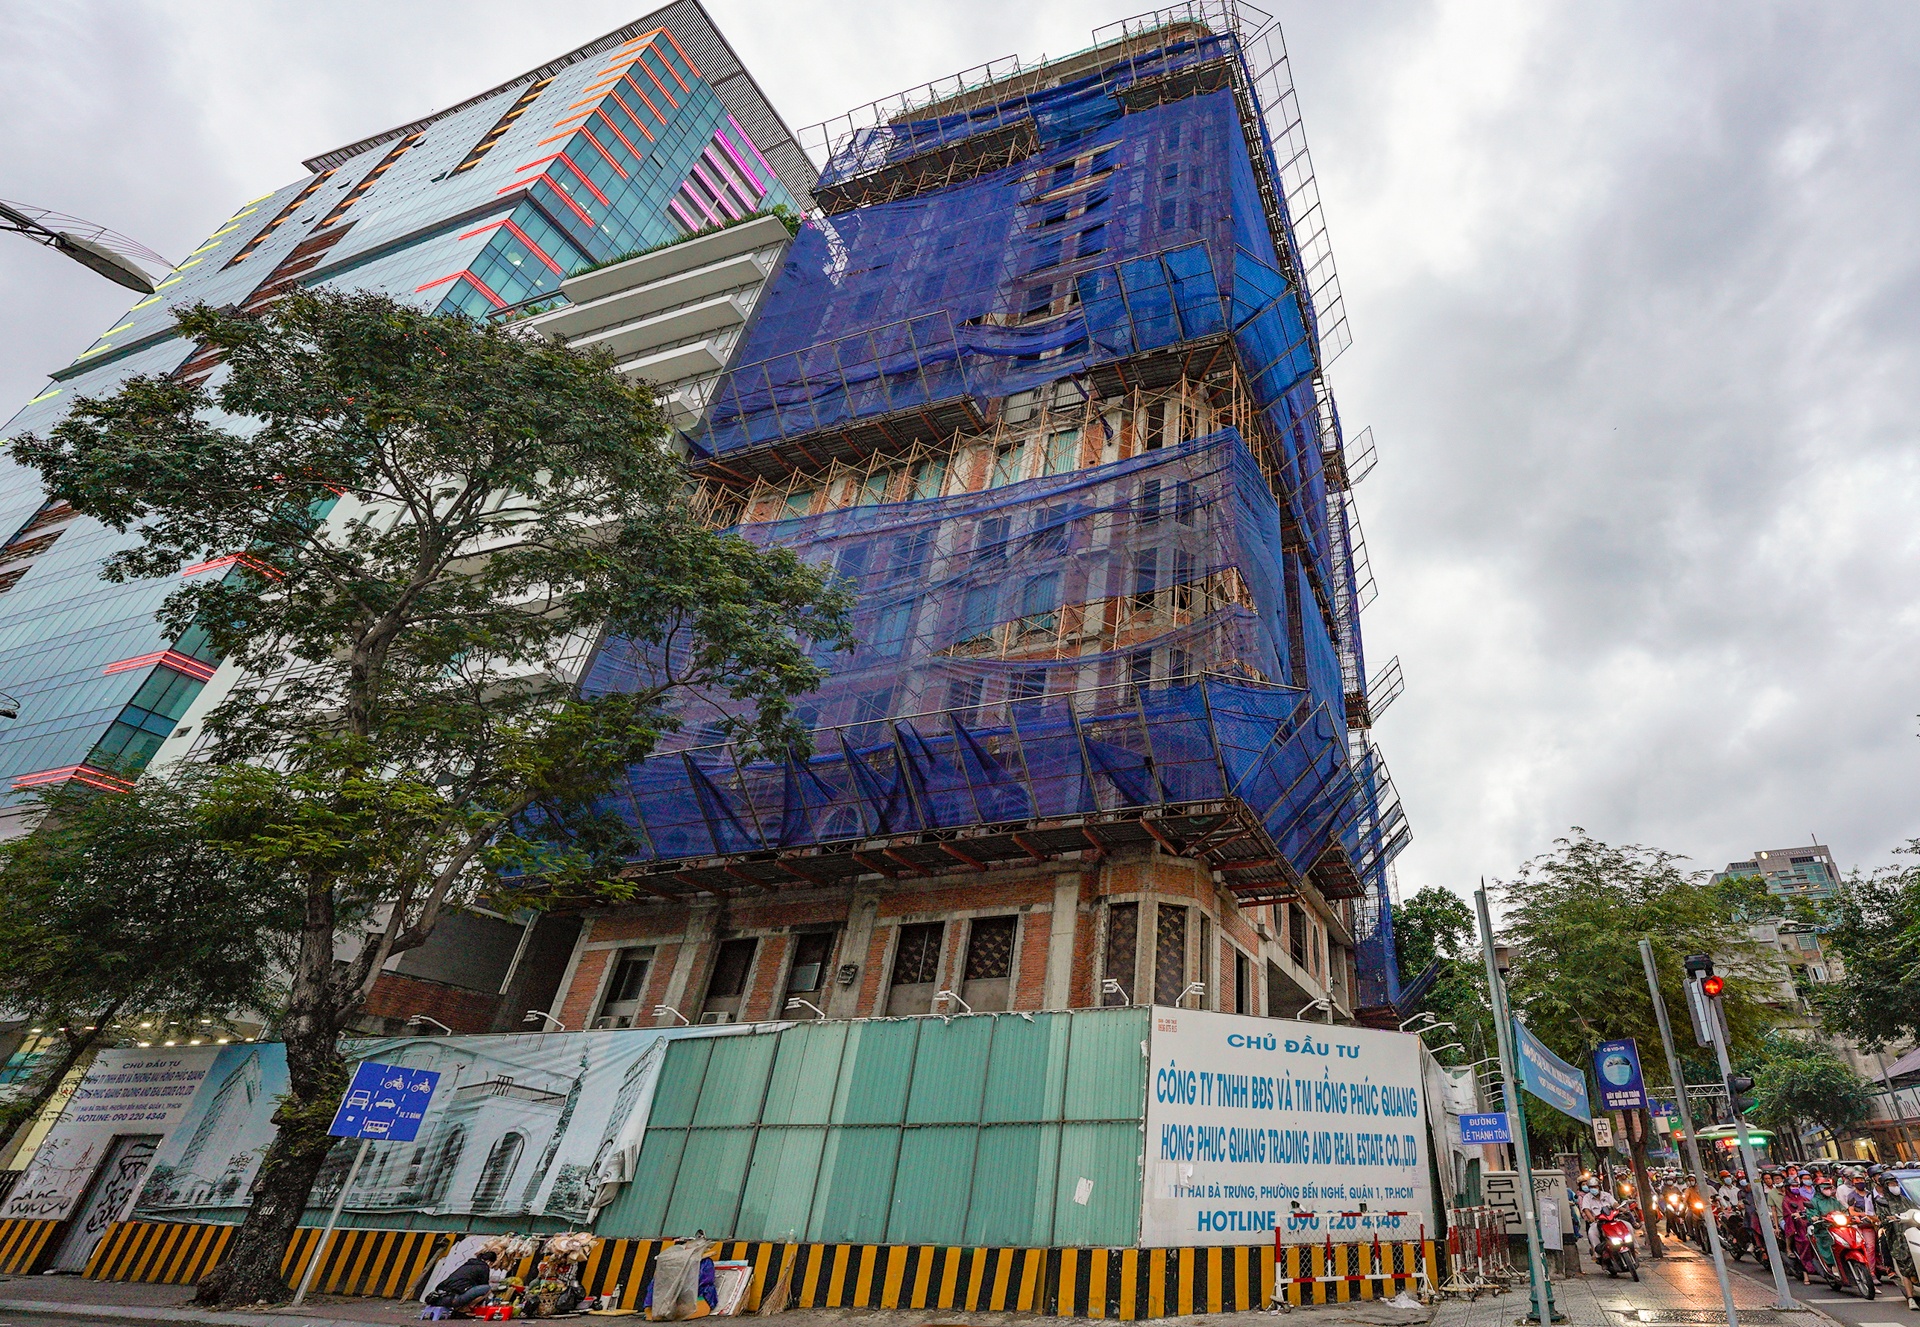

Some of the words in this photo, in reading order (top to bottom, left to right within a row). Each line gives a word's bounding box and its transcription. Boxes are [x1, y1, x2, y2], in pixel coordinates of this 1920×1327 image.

[1227, 1032, 1276, 1051] CHỦ
[1285, 1035, 1329, 1056] ĐẦU
[1336, 1044, 1360, 1059] TƯ
[123, 1061, 144, 1069] CHỦ
[1157, 1060, 1196, 1104] CÔNG
[1200, 1071, 1213, 1106] TY
[1217, 1074, 1247, 1108] TNHH
[1252, 1076, 1273, 1110] BĐS
[1277, 1068, 1292, 1112] VÀ
[1297, 1080, 1312, 1112] TM
[1316, 1066, 1347, 1114] HỒNG
[1351, 1076, 1379, 1117] PHÚC
[1382, 1086, 1418, 1118] QUANG
[76, 1114, 112, 1122] HOTLINE:
[112, 1113, 127, 1121] 090
[128, 1112, 144, 1120] 220
[146, 1112, 166, 1120] 4348
[1469, 1117, 1498, 1126] ĐƯỜNG
[1462, 1130, 1471, 1141] LÊ
[1472, 1128, 1494, 1141] THÁNH
[1494, 1128, 1508, 1139] TÔN
[1162, 1124, 1193, 1162] HONG
[1198, 1126, 1226, 1162] PHUC
[1229, 1128, 1266, 1164] QUANG
[1269, 1130, 1309, 1164] TRADING
[1313, 1132, 1331, 1165] AND
[1335, 1133, 1356, 1166] REAL
[1358, 1134, 1384, 1166] ESTATE
[1187, 1185, 1205, 1198] HAI
[1208, 1181, 1220, 1198] BÀ
[1224, 1184, 1258, 1201] TRƯNG,
[1261, 1182, 1299, 1199] PHƯỜNG
[1303, 1181, 1318, 1199] BẾN
[1321, 1182, 1346, 1201] NGHÉ,
[1349, 1186, 1373, 1202] QUẬN
[1376, 1187, 1383, 1201] 1,
[1385, 1187, 1413, 1200] TP.HCM
